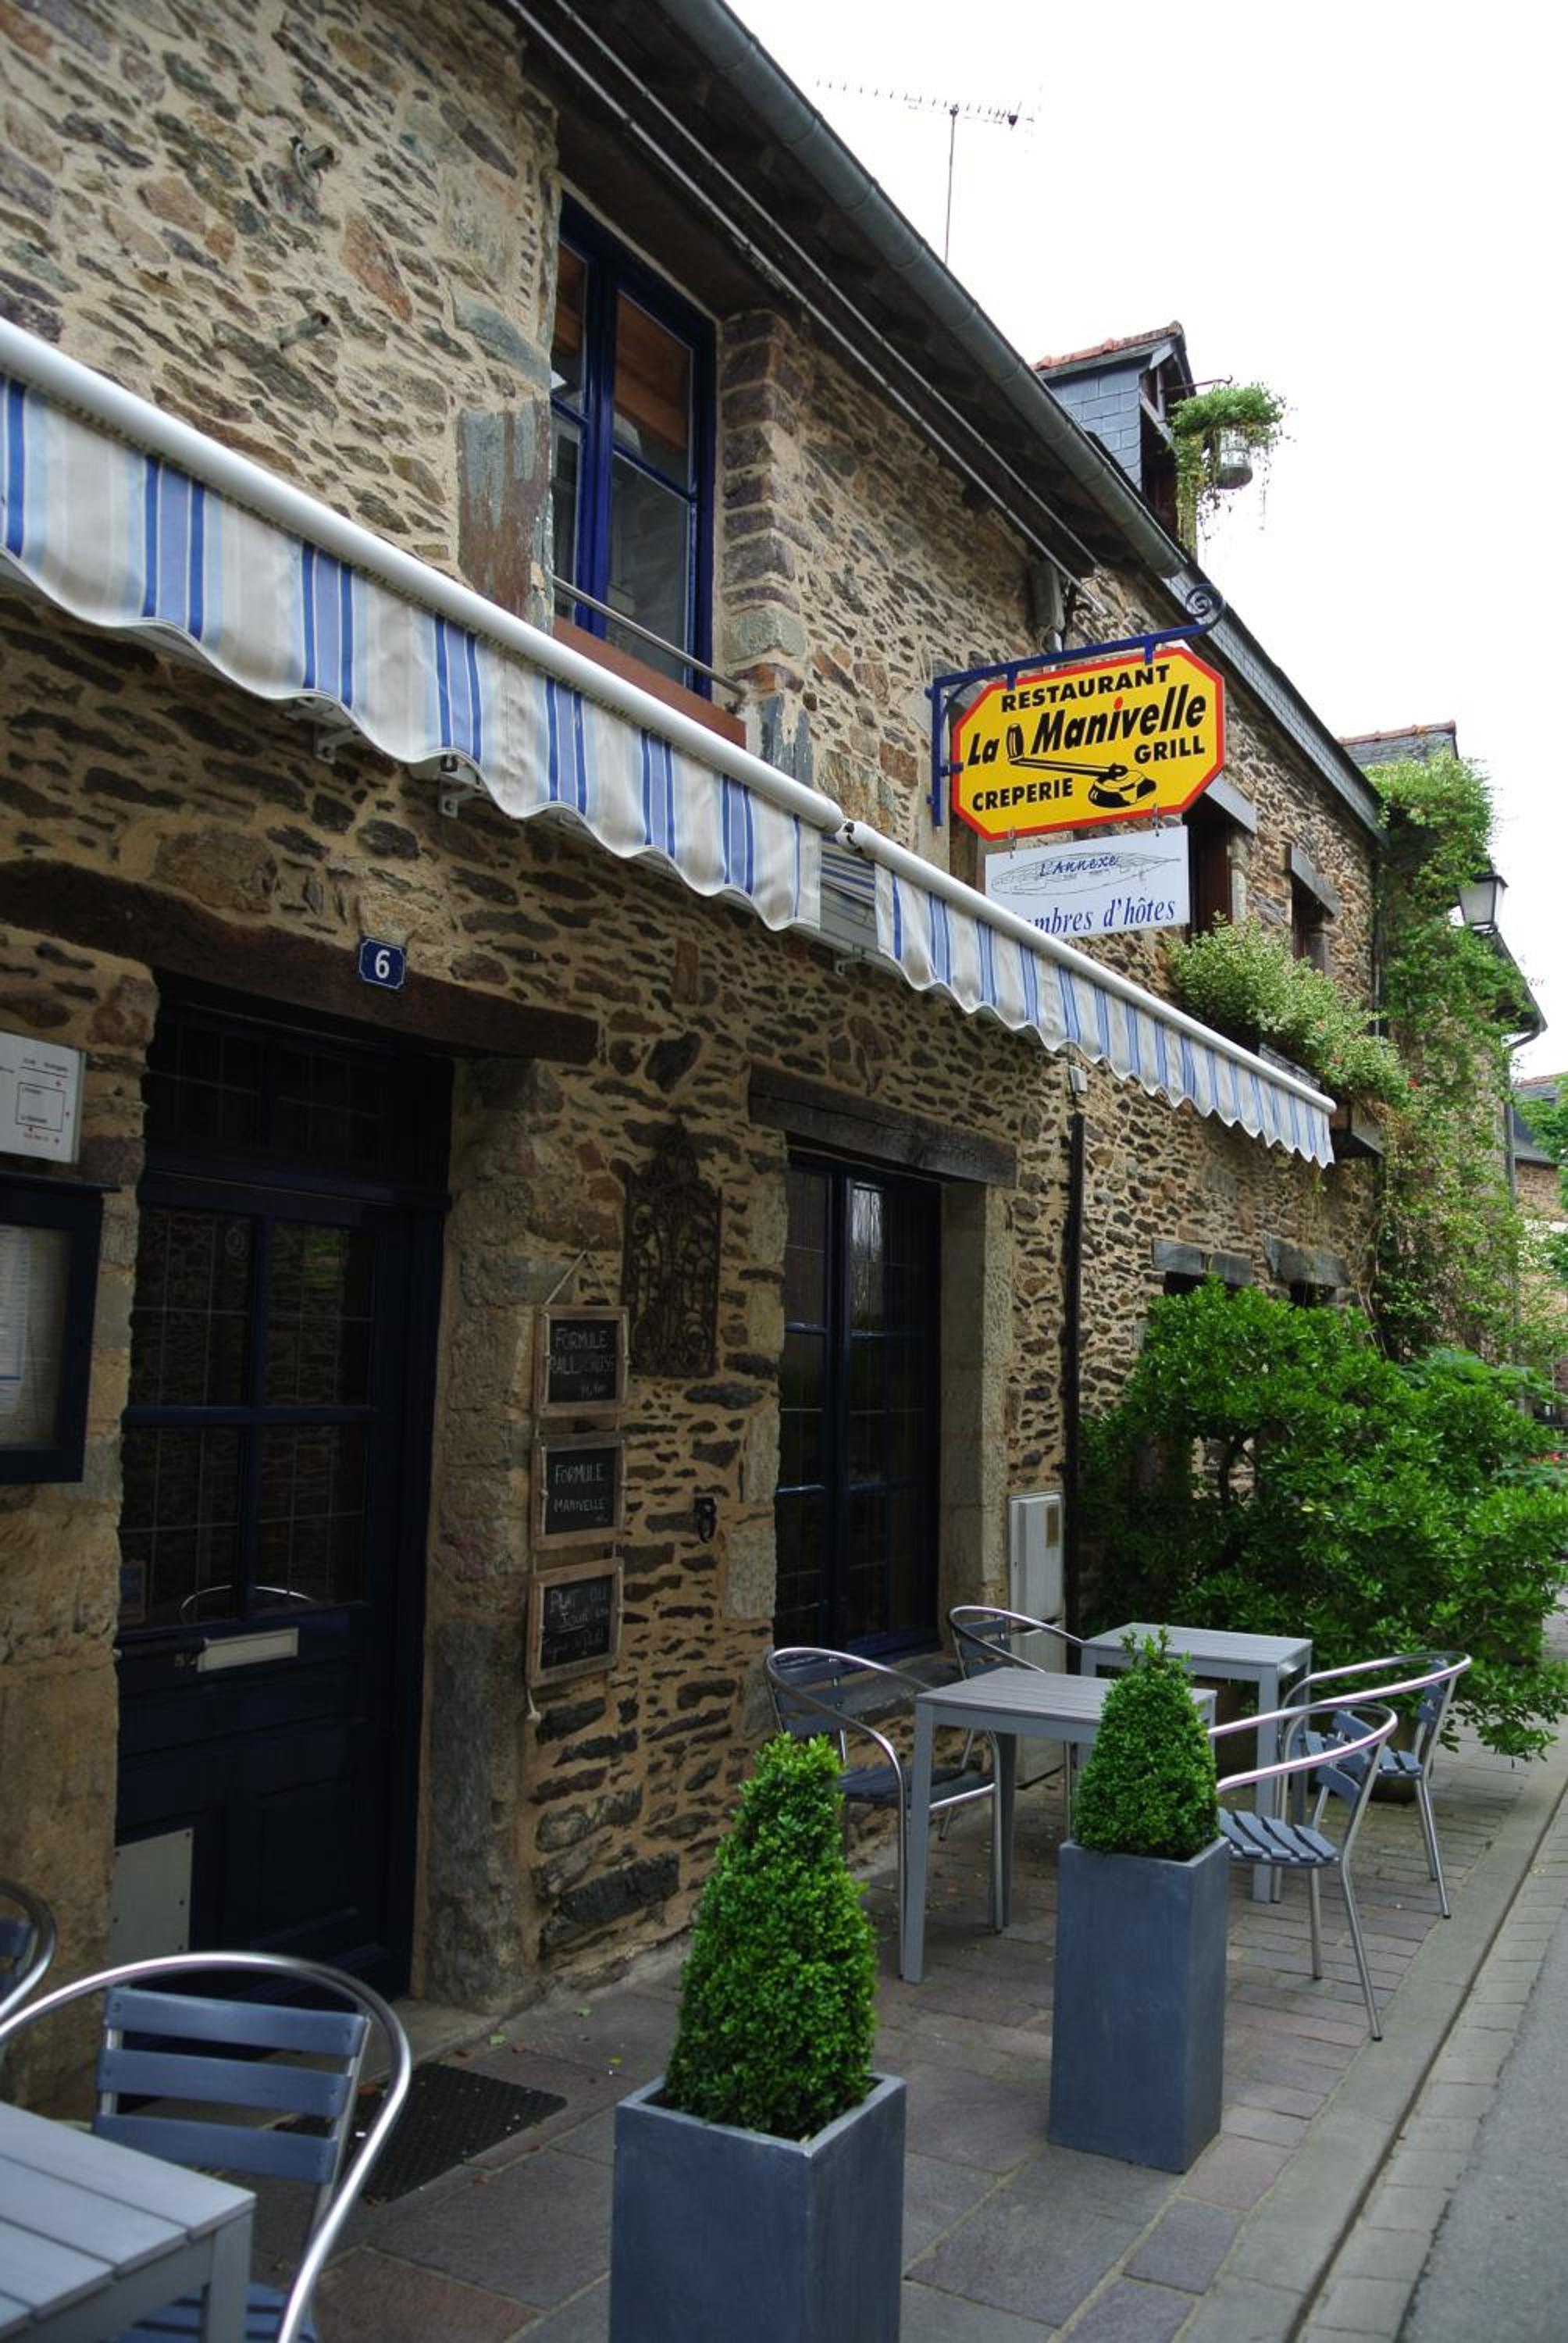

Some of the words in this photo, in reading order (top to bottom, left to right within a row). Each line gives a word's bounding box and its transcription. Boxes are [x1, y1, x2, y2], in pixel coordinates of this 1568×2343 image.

[1002, 665, 1170, 712] RESTAURANT
[968, 733, 1000, 766] La
[1030, 684, 1207, 755] Manivelle
[1134, 735, 1206, 764] GRILL
[972, 778, 1073, 811] CREPERIE
[1027, 907, 1092, 934] mbres
[1103, 897, 1175, 927] d'hôtes
[376, 949, 390, 979] 6
[554, 1462, 606, 1485] FORMULE
